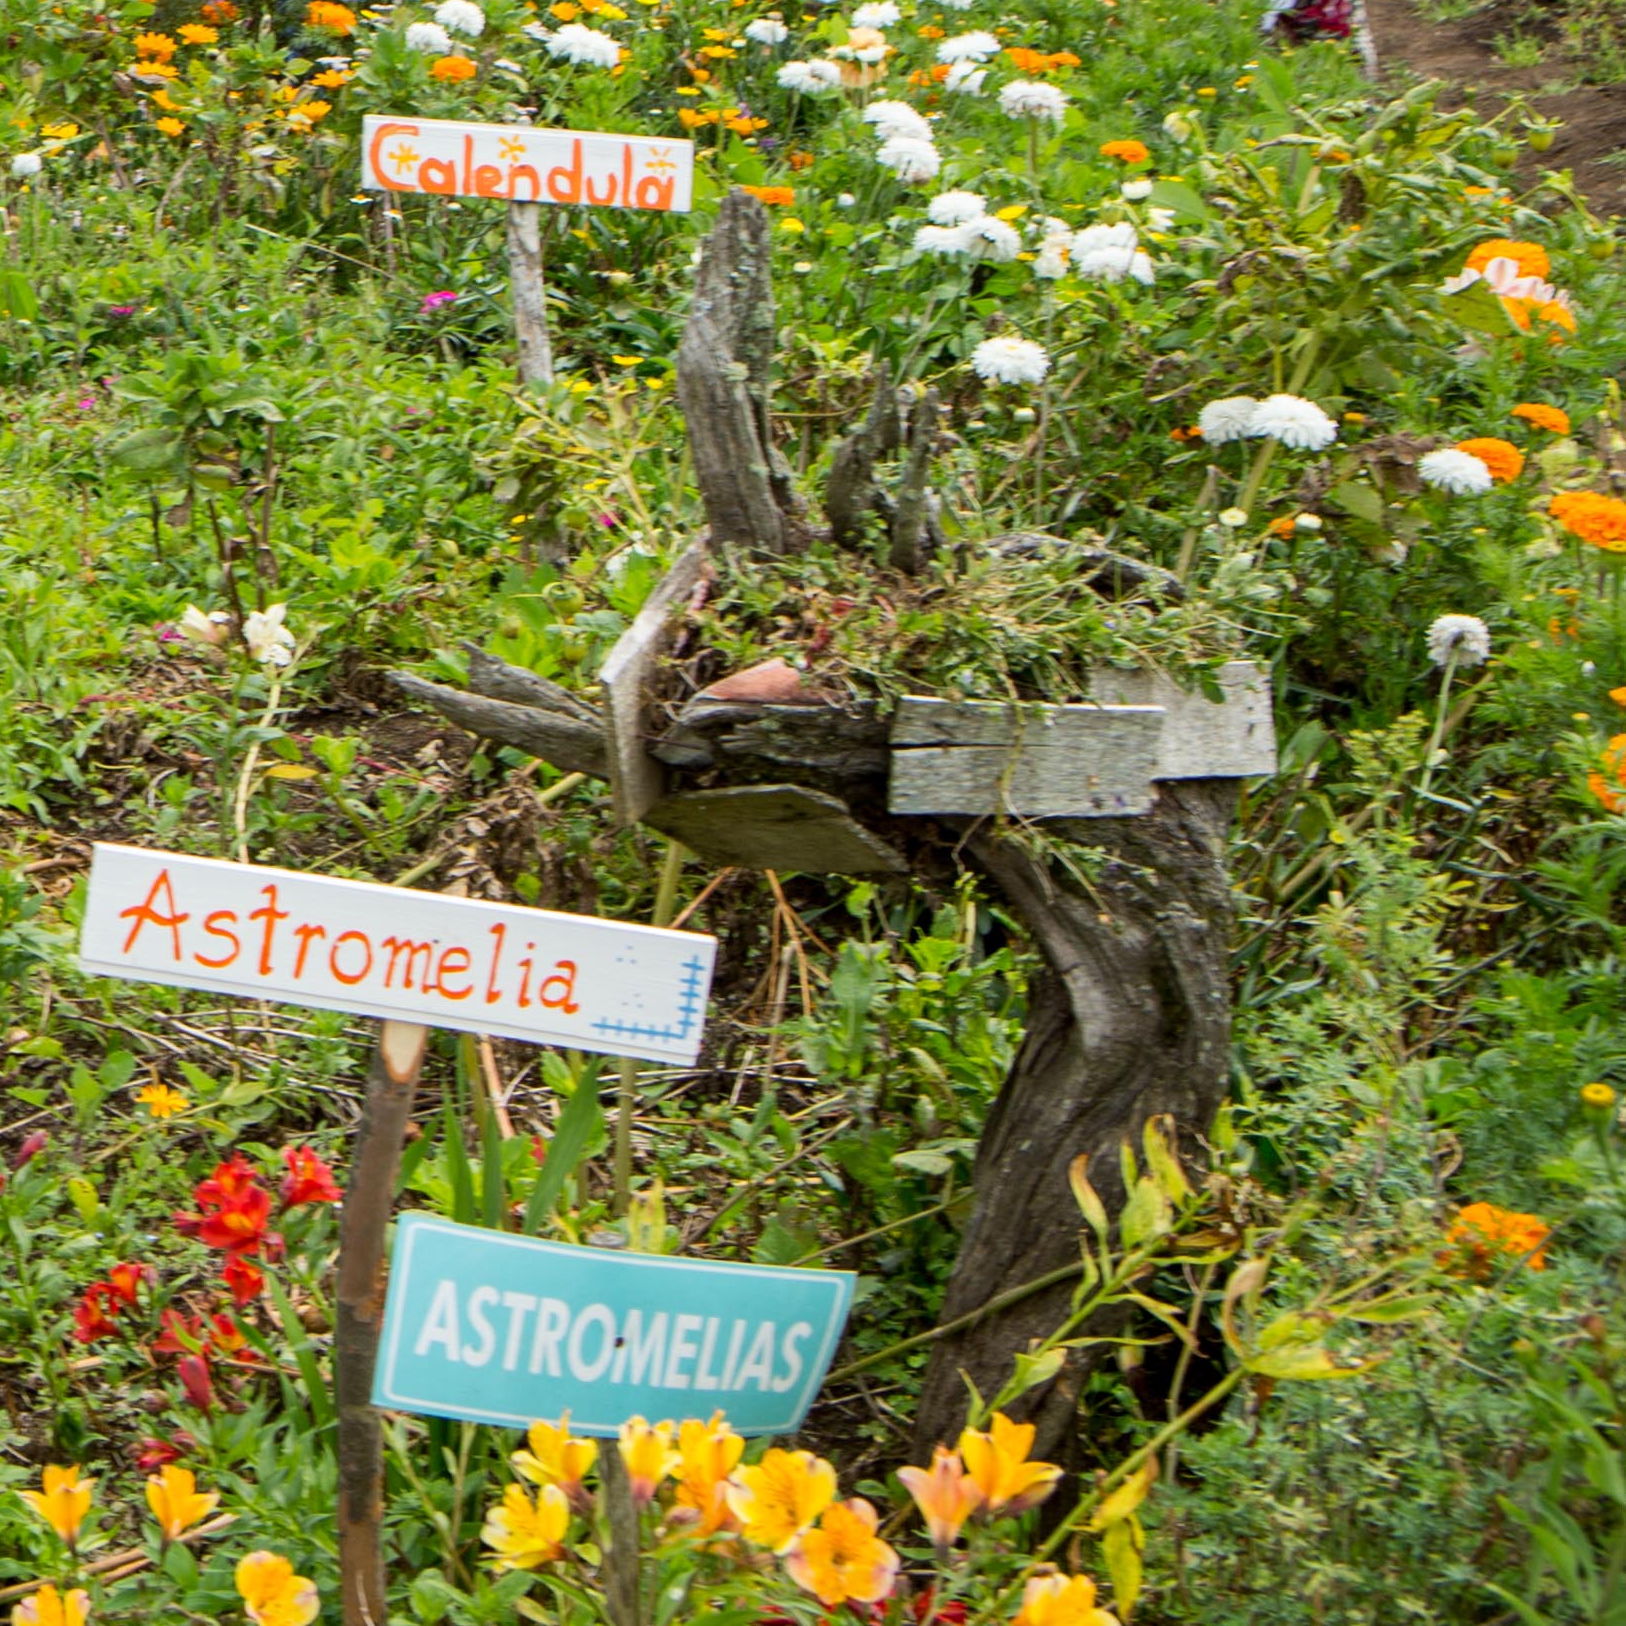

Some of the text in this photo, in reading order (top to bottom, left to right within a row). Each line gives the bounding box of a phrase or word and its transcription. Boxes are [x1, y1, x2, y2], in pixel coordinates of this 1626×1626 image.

[369, 122, 675, 212] Calendula
[119, 868, 580, 1015] Astromelia
[413, 1278, 813, 1393] ASTROMELIAS
